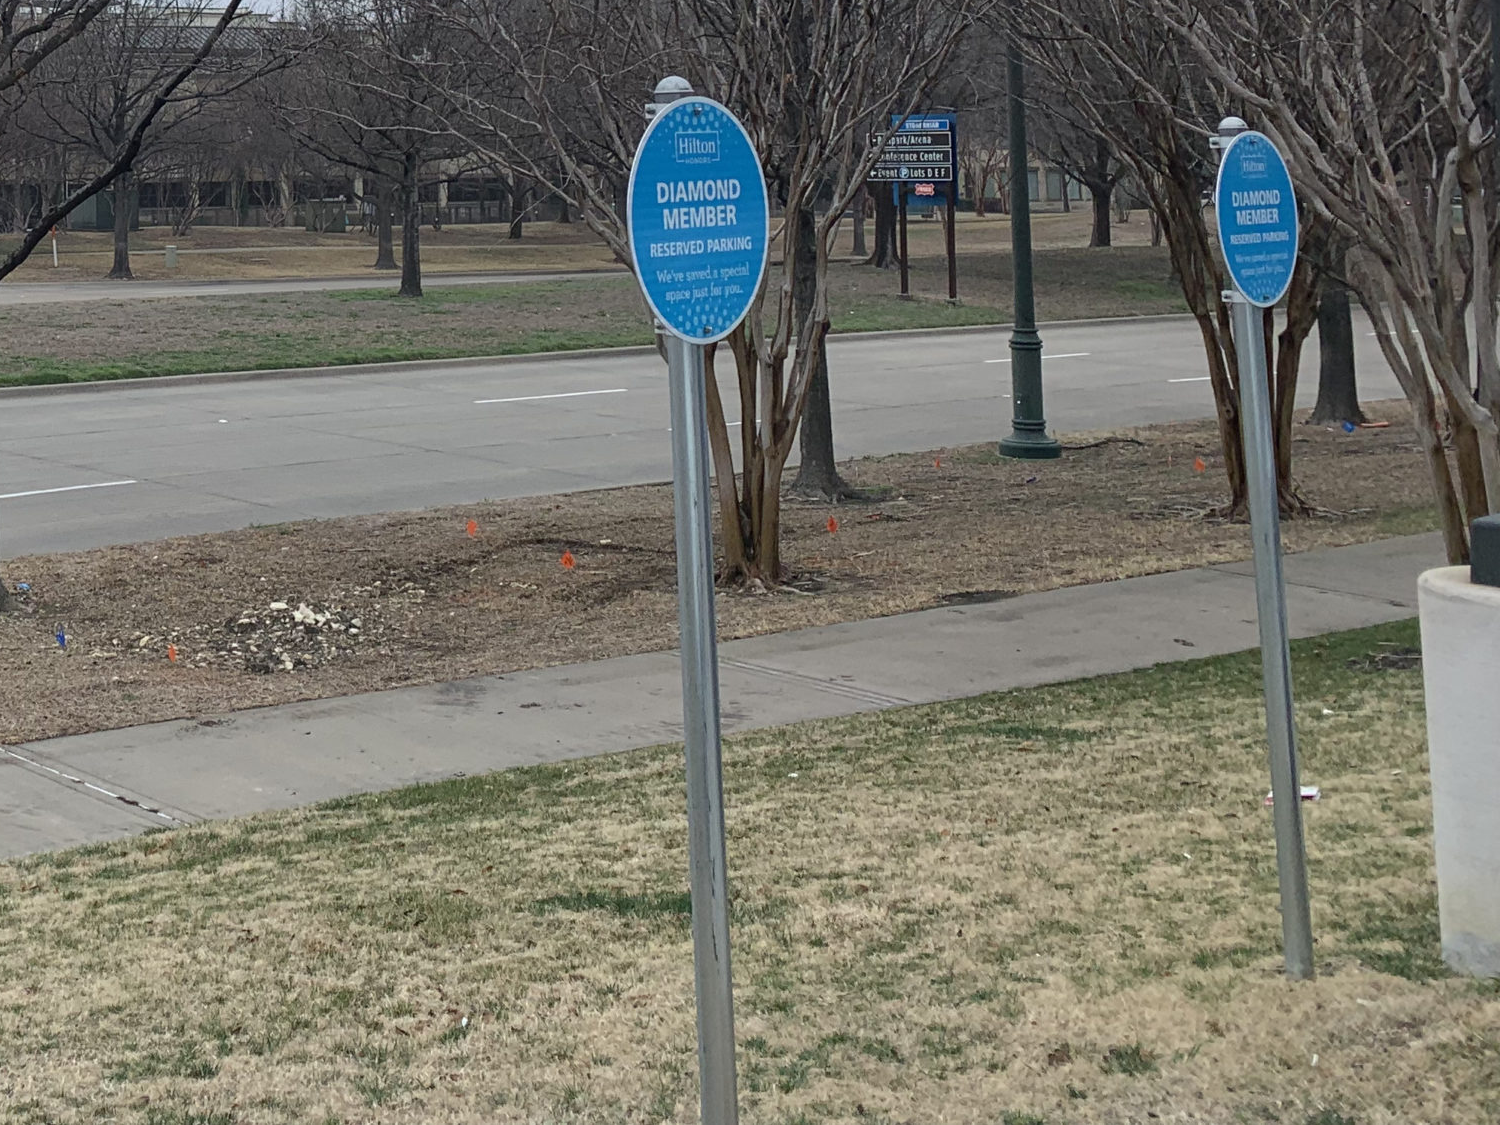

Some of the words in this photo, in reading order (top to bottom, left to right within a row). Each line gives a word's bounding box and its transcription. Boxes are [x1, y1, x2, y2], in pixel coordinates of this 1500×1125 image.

[678, 137, 716, 155] Hilton
[877, 135, 932, 146] Bpark/Arena
[878, 151, 918, 162] nference
[919, 151, 944, 161] Center
[877, 168, 898, 178] Event
[910, 168, 926, 178] Lots
[927, 168, 933, 177] D
[934, 168, 940, 177] E
[941, 168, 946, 177] F
[656, 178, 741, 204] DIAMOND
[1231, 189, 1280, 207] DIAMOND
[662, 204, 737, 230] MEMBER
[1236, 208, 1280, 226] MEMBER
[650, 239, 704, 258] RESERVED
[707, 235, 752, 253] PARKING
